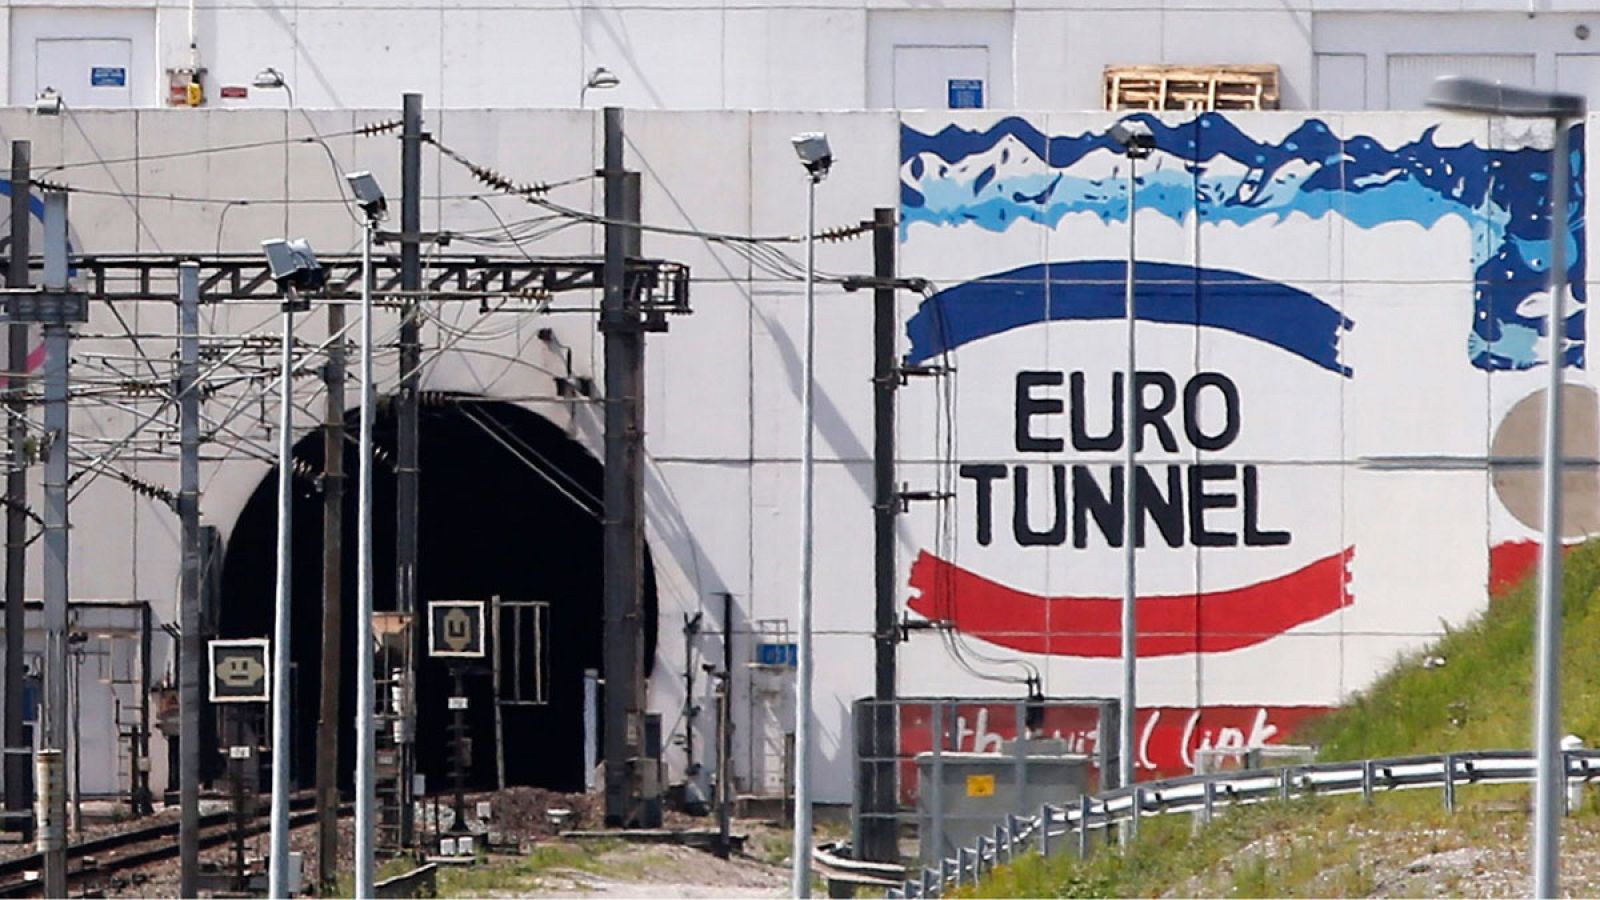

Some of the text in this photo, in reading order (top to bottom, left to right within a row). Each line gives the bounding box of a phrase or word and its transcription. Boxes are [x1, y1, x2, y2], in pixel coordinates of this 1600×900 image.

[1015, 371, 1240, 452] EURO
[960, 464, 1291, 548] TUNNEL
[945, 707, 1030, 754] th
